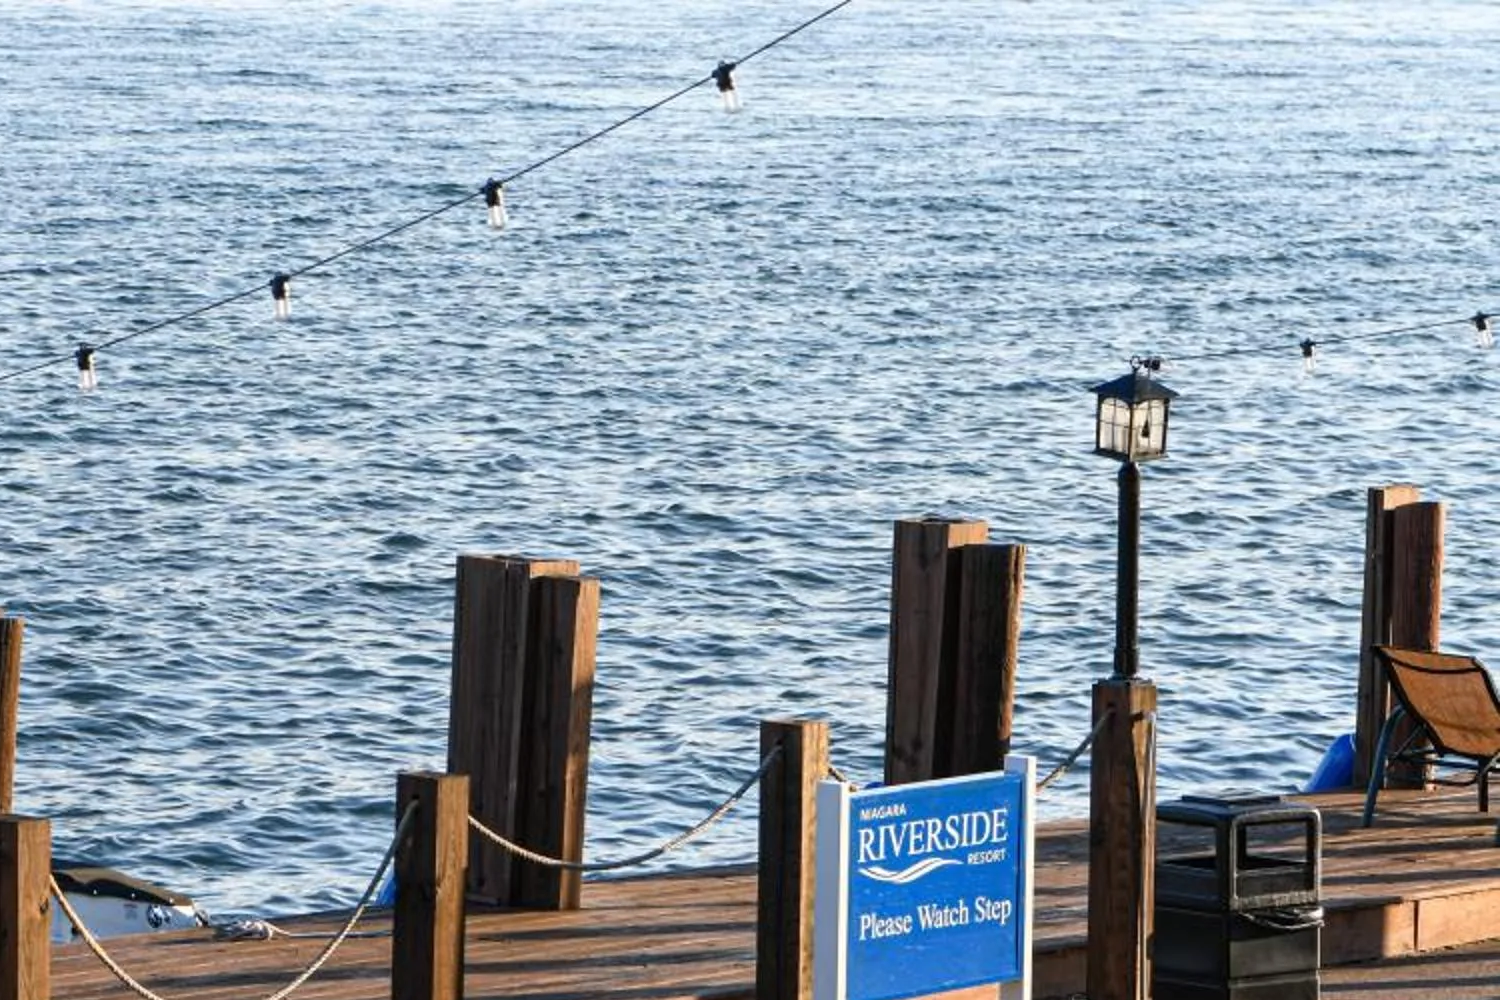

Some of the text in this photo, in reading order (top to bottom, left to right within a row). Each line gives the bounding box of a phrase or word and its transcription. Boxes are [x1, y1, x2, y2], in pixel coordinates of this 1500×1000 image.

[859, 803, 907, 821] NIAGARA
[857, 808, 1009, 863] RIVERSIDE
[967, 848, 1007, 865] RESORT
[859, 895, 1012, 941] Please Watch Step
